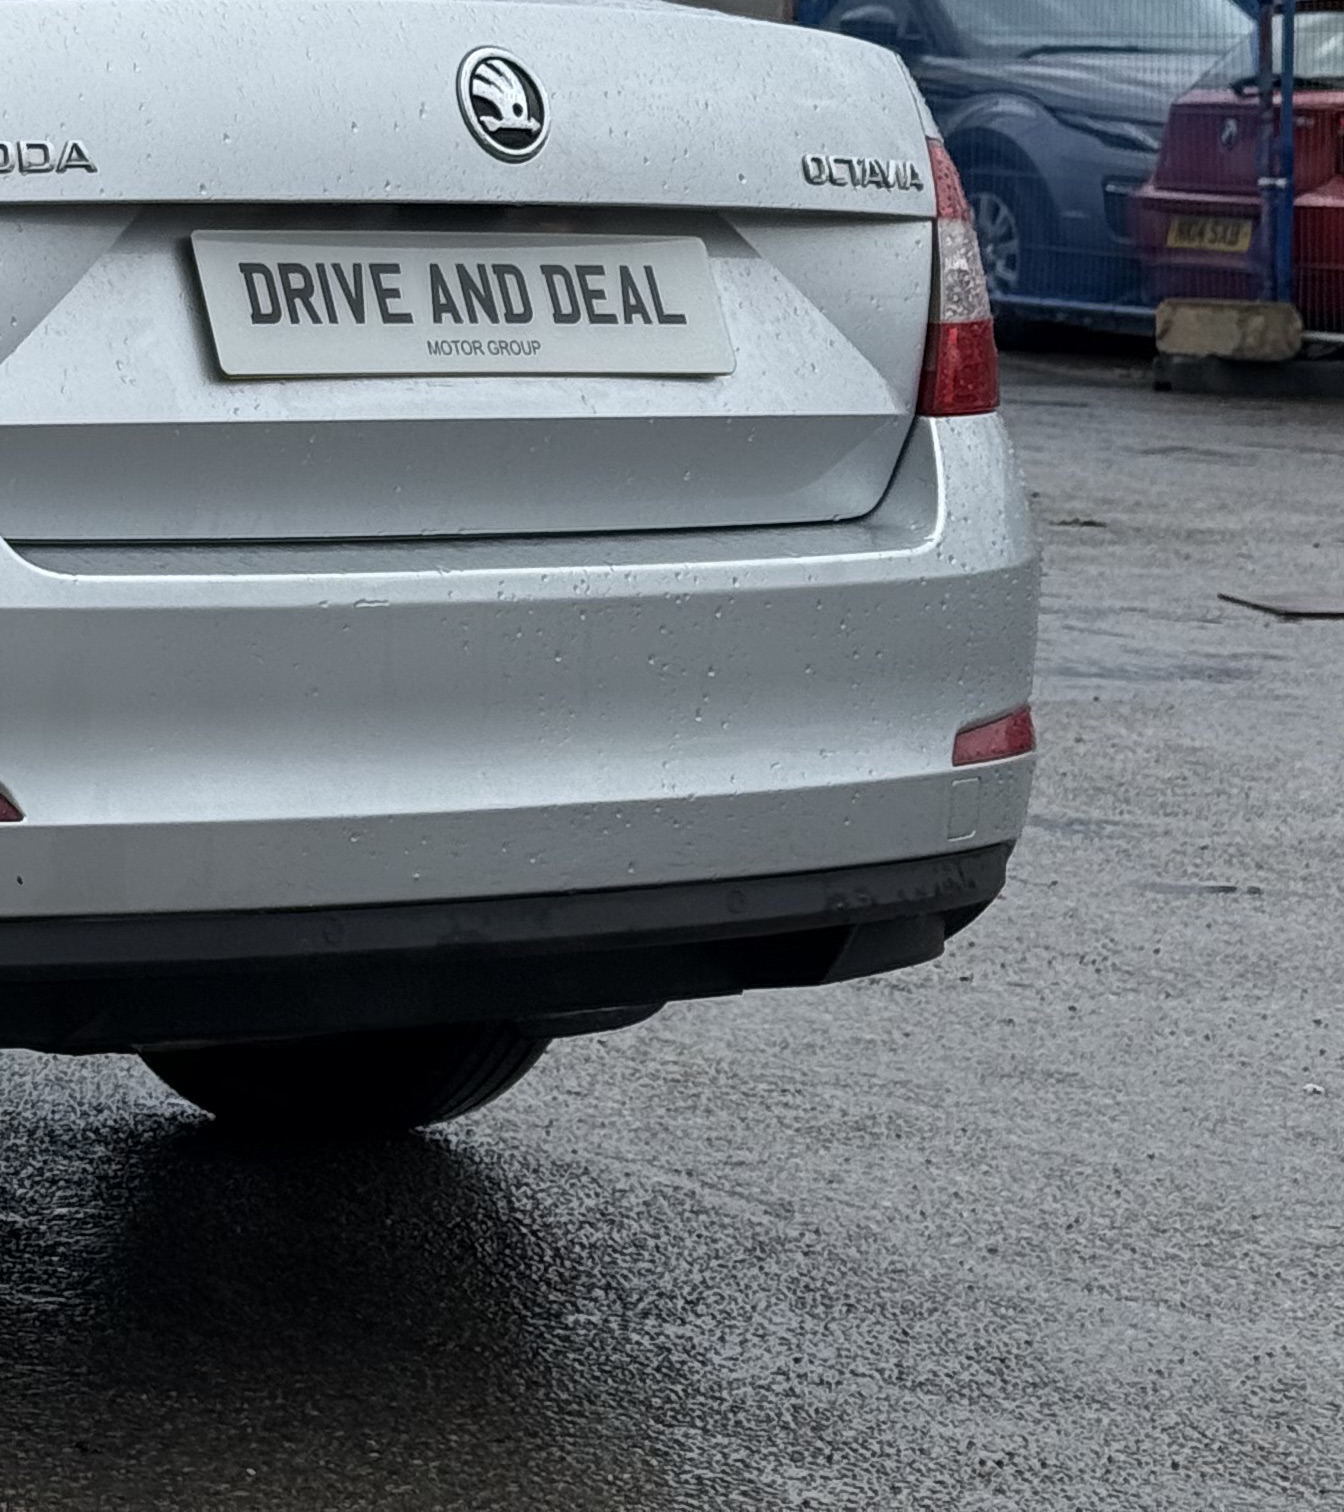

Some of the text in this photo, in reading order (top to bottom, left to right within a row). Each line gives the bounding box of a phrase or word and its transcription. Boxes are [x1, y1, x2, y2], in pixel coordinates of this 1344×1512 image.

[801, 154, 925, 193] OCTAVIA
[238, 262, 688, 326] DRIVE AND DEAL
[427, 339, 542, 357] MOTOR GROUP
